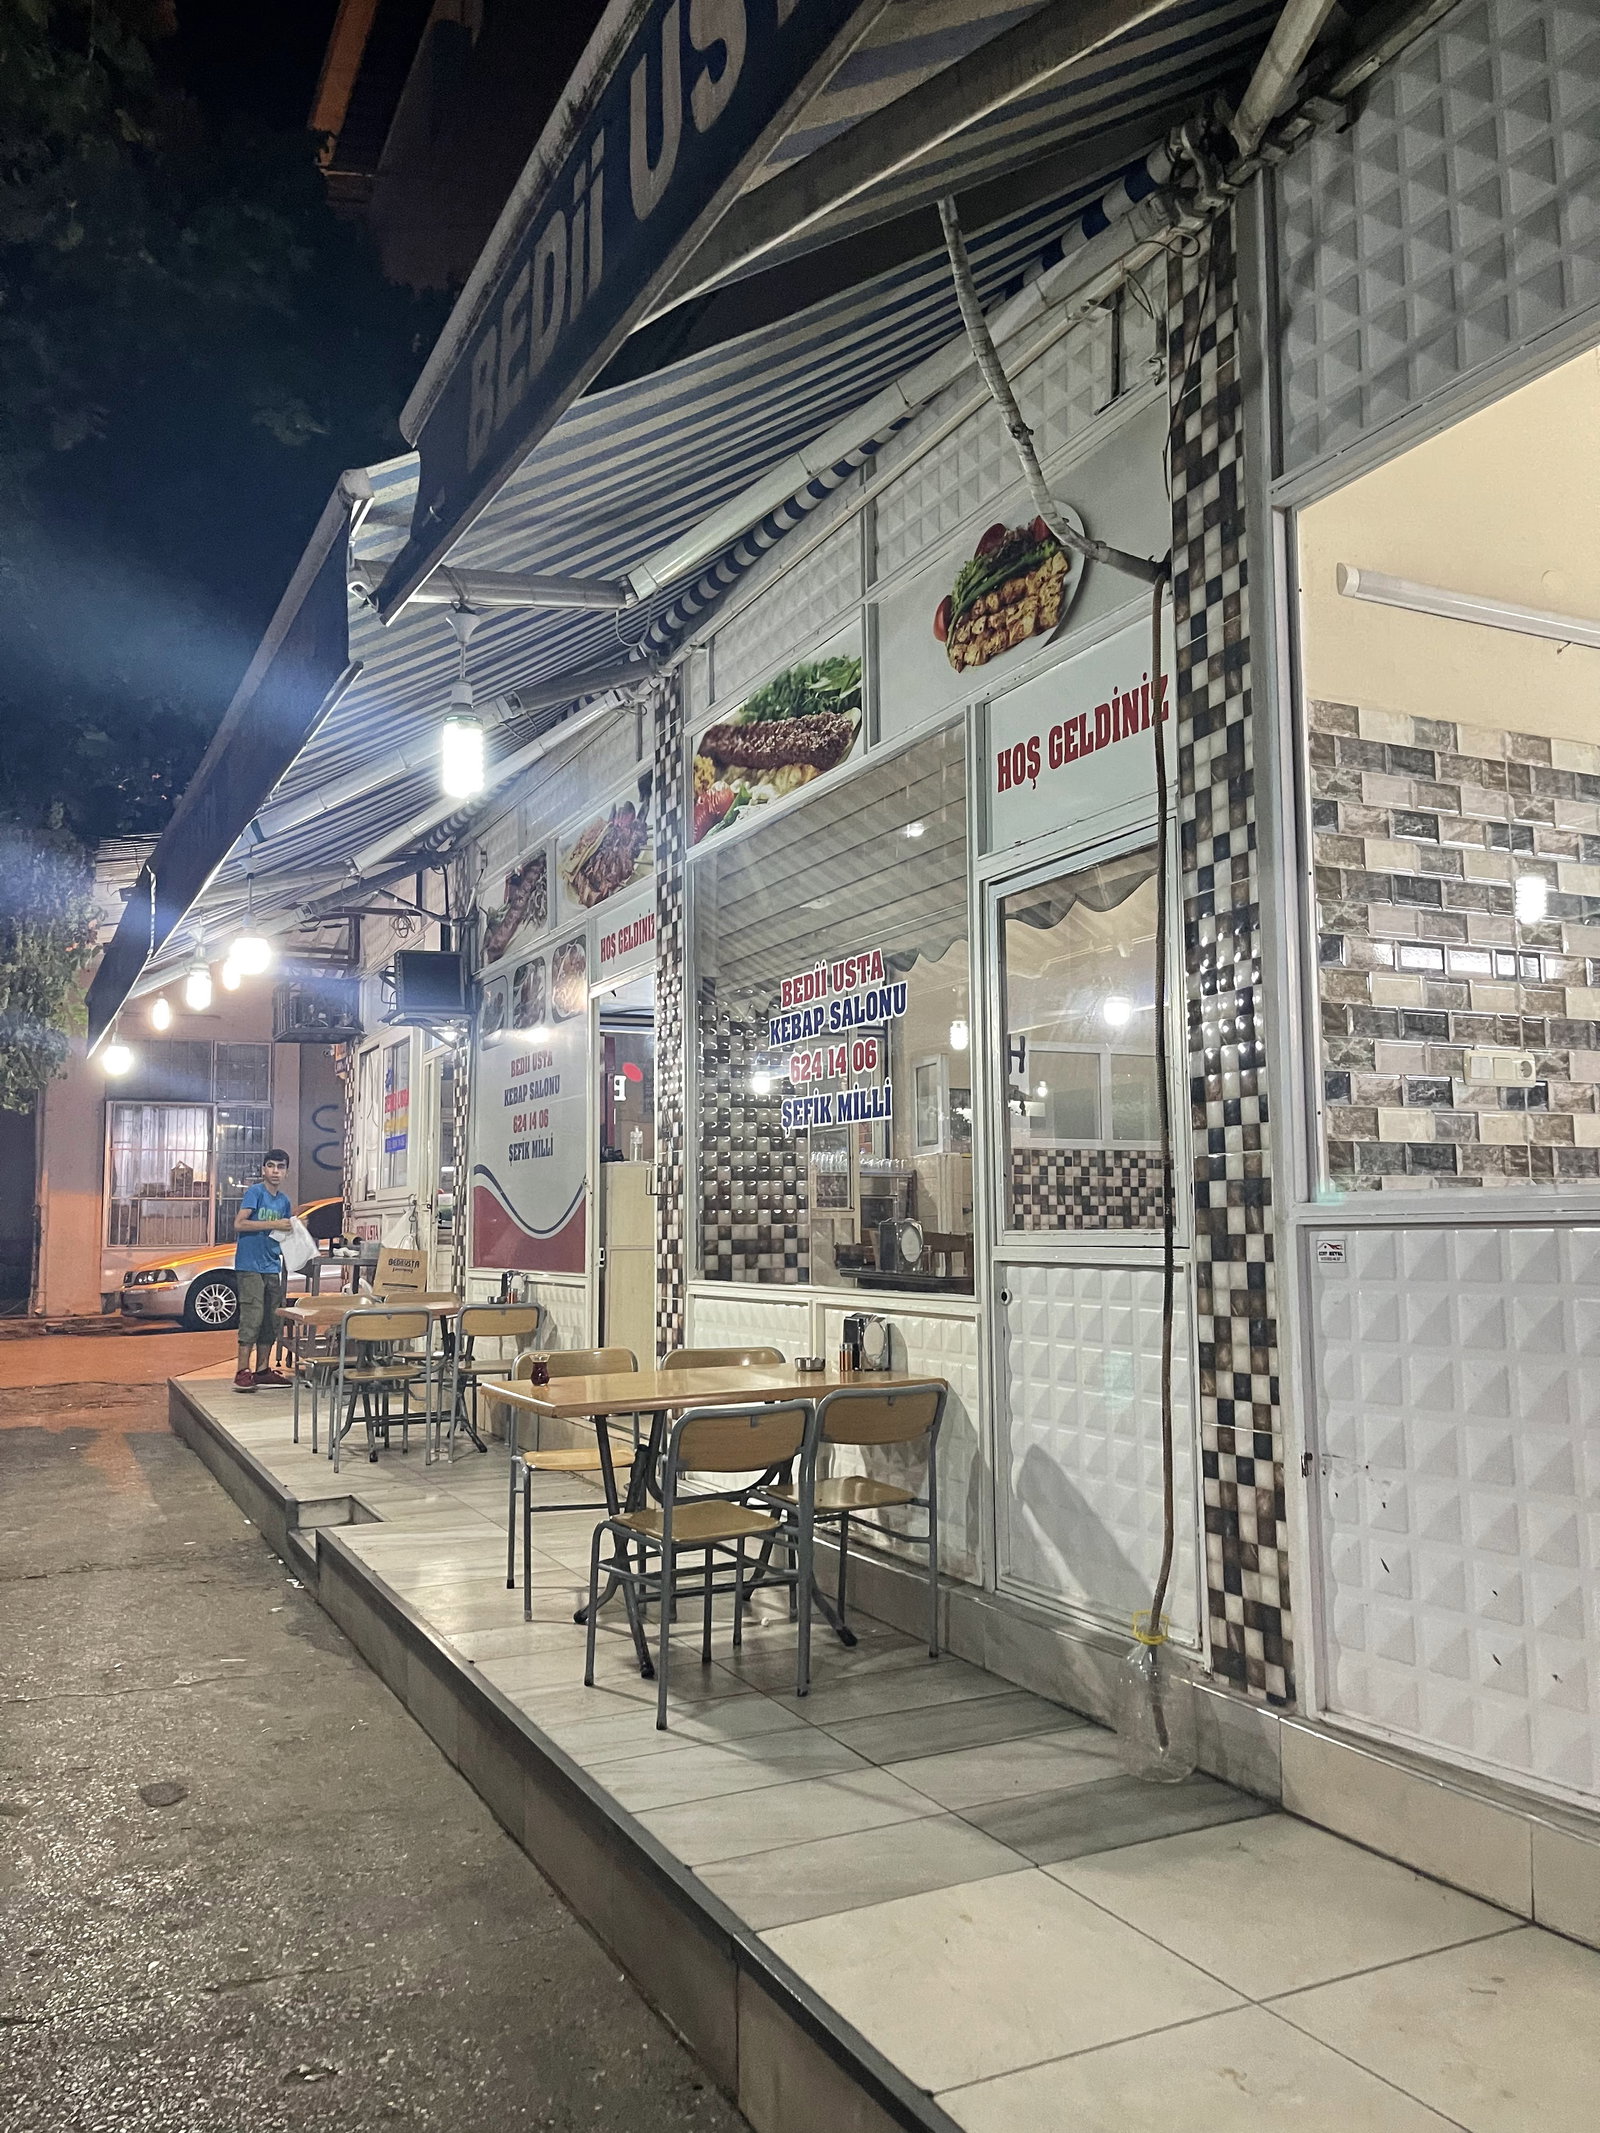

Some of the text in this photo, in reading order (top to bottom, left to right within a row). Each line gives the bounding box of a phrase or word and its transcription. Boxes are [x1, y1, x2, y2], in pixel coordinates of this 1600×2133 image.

[997, 672, 1169, 793] HOŞ GELDİNİZ
[600, 908, 655, 965] HOŞ GELDİNİZ
[781, 949, 884, 1009] BEDİİ USTA
[769, 982, 908, 1047] KEBAP SALONU
[532, 1049, 553, 1071] USTA
[789, 1038, 878, 1084] 624 14 06
[503, 1074, 560, 1107] KEBAP SALONU
[782, 1078, 892, 1137] ŞEFİK MİLLİ
[512, 1108, 549, 1134] 624 14 06
[508, 1132, 554, 1167] ŞEFİK MİLLİ
